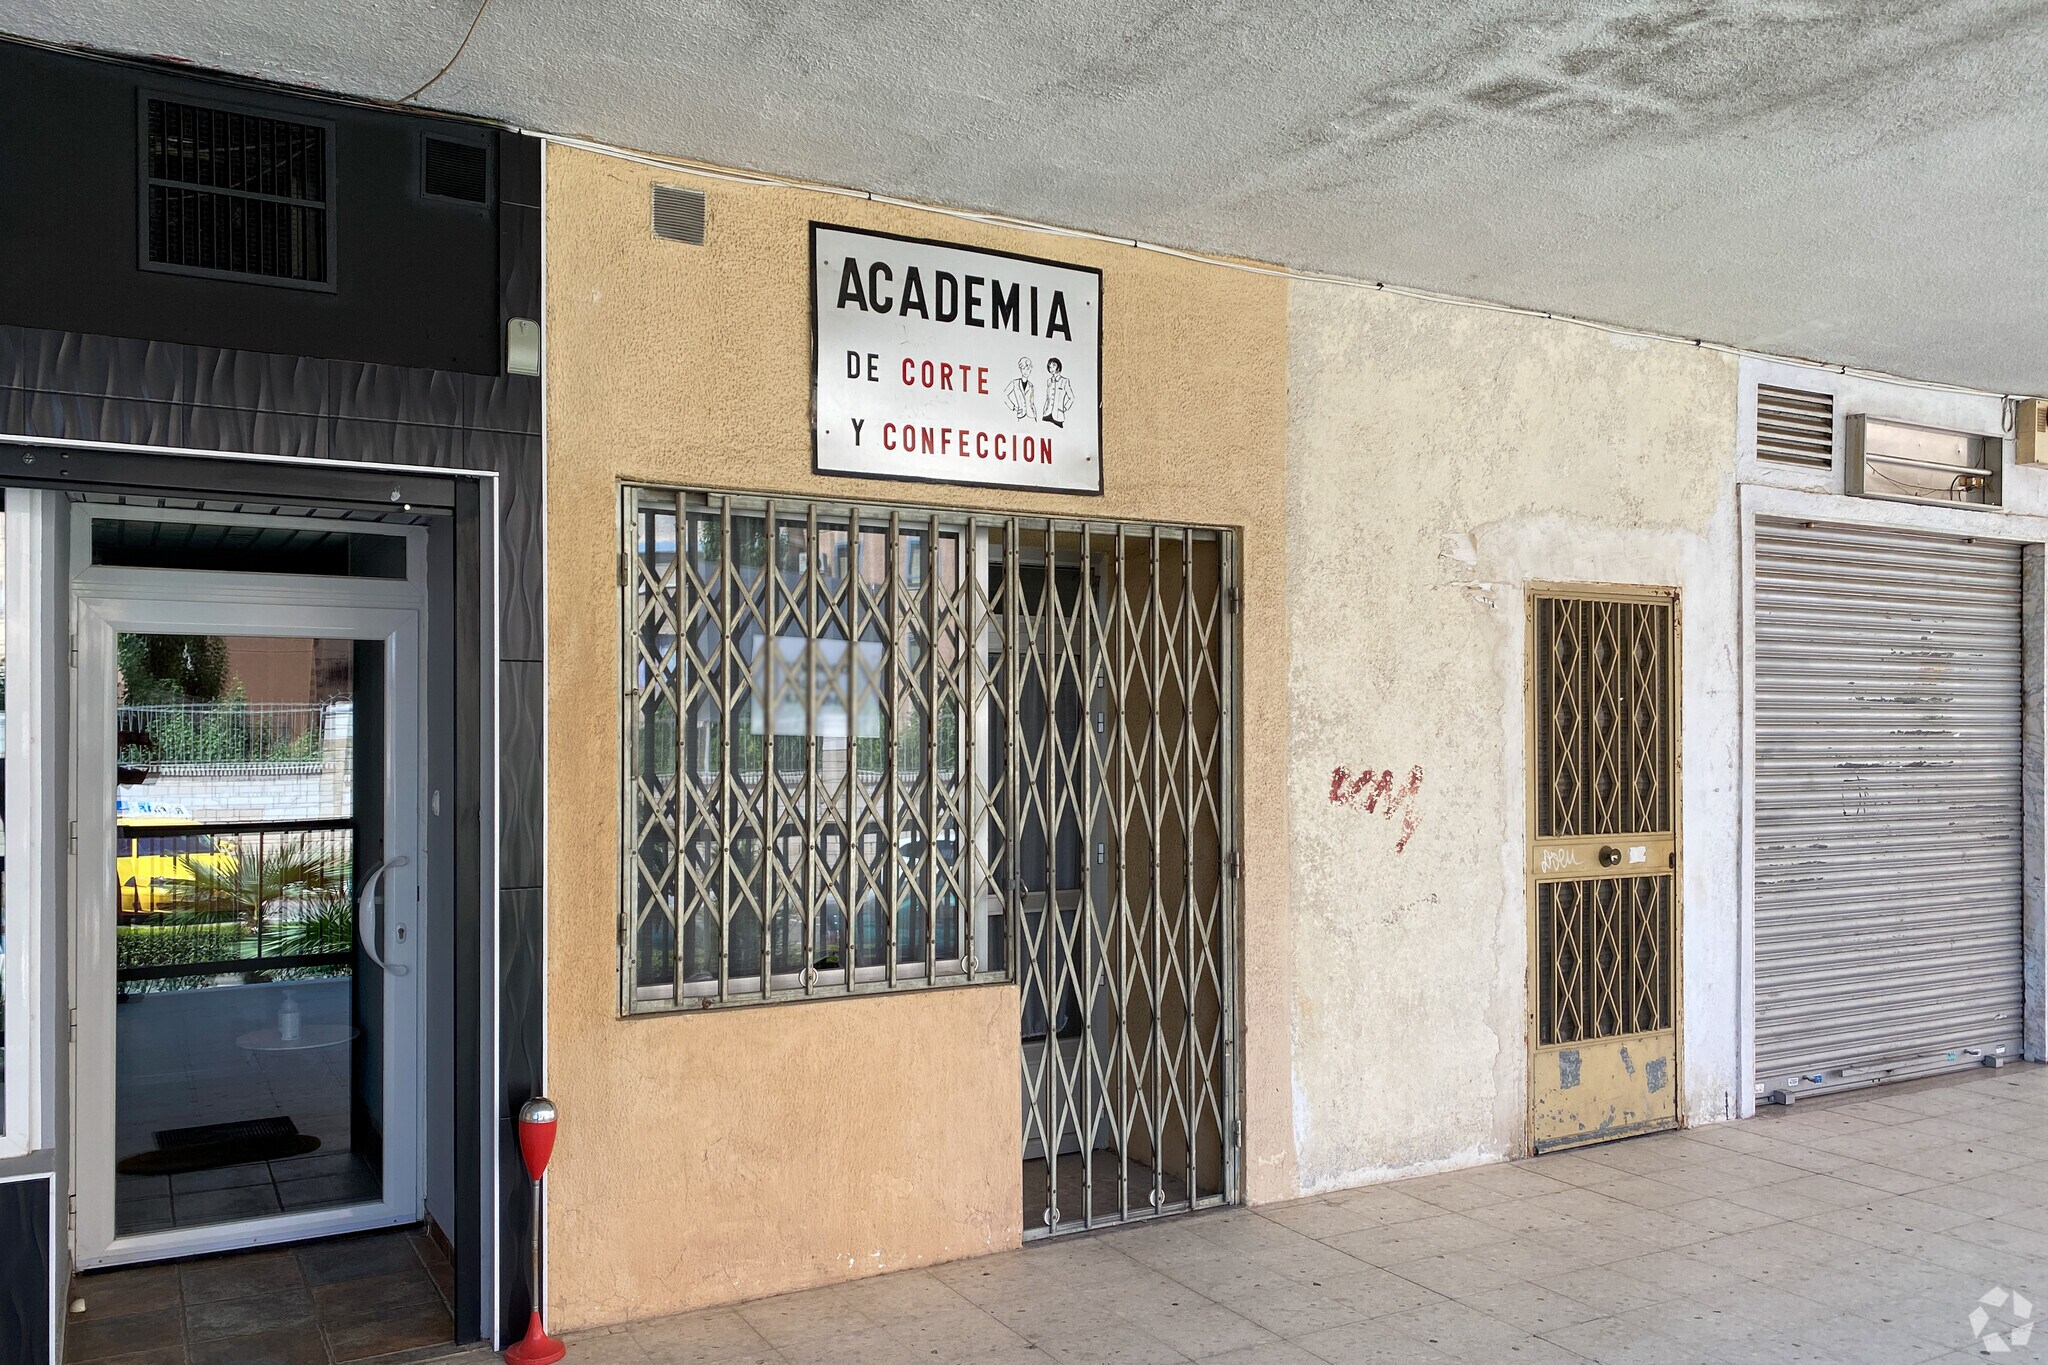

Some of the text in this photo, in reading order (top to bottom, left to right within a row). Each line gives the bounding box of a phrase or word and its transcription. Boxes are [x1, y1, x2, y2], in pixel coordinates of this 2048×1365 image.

[836, 256, 1073, 342] ACADEMIA
[846, 350, 990, 396] DE CORTE
[851, 418, 1053, 465] Y CONFECCION
